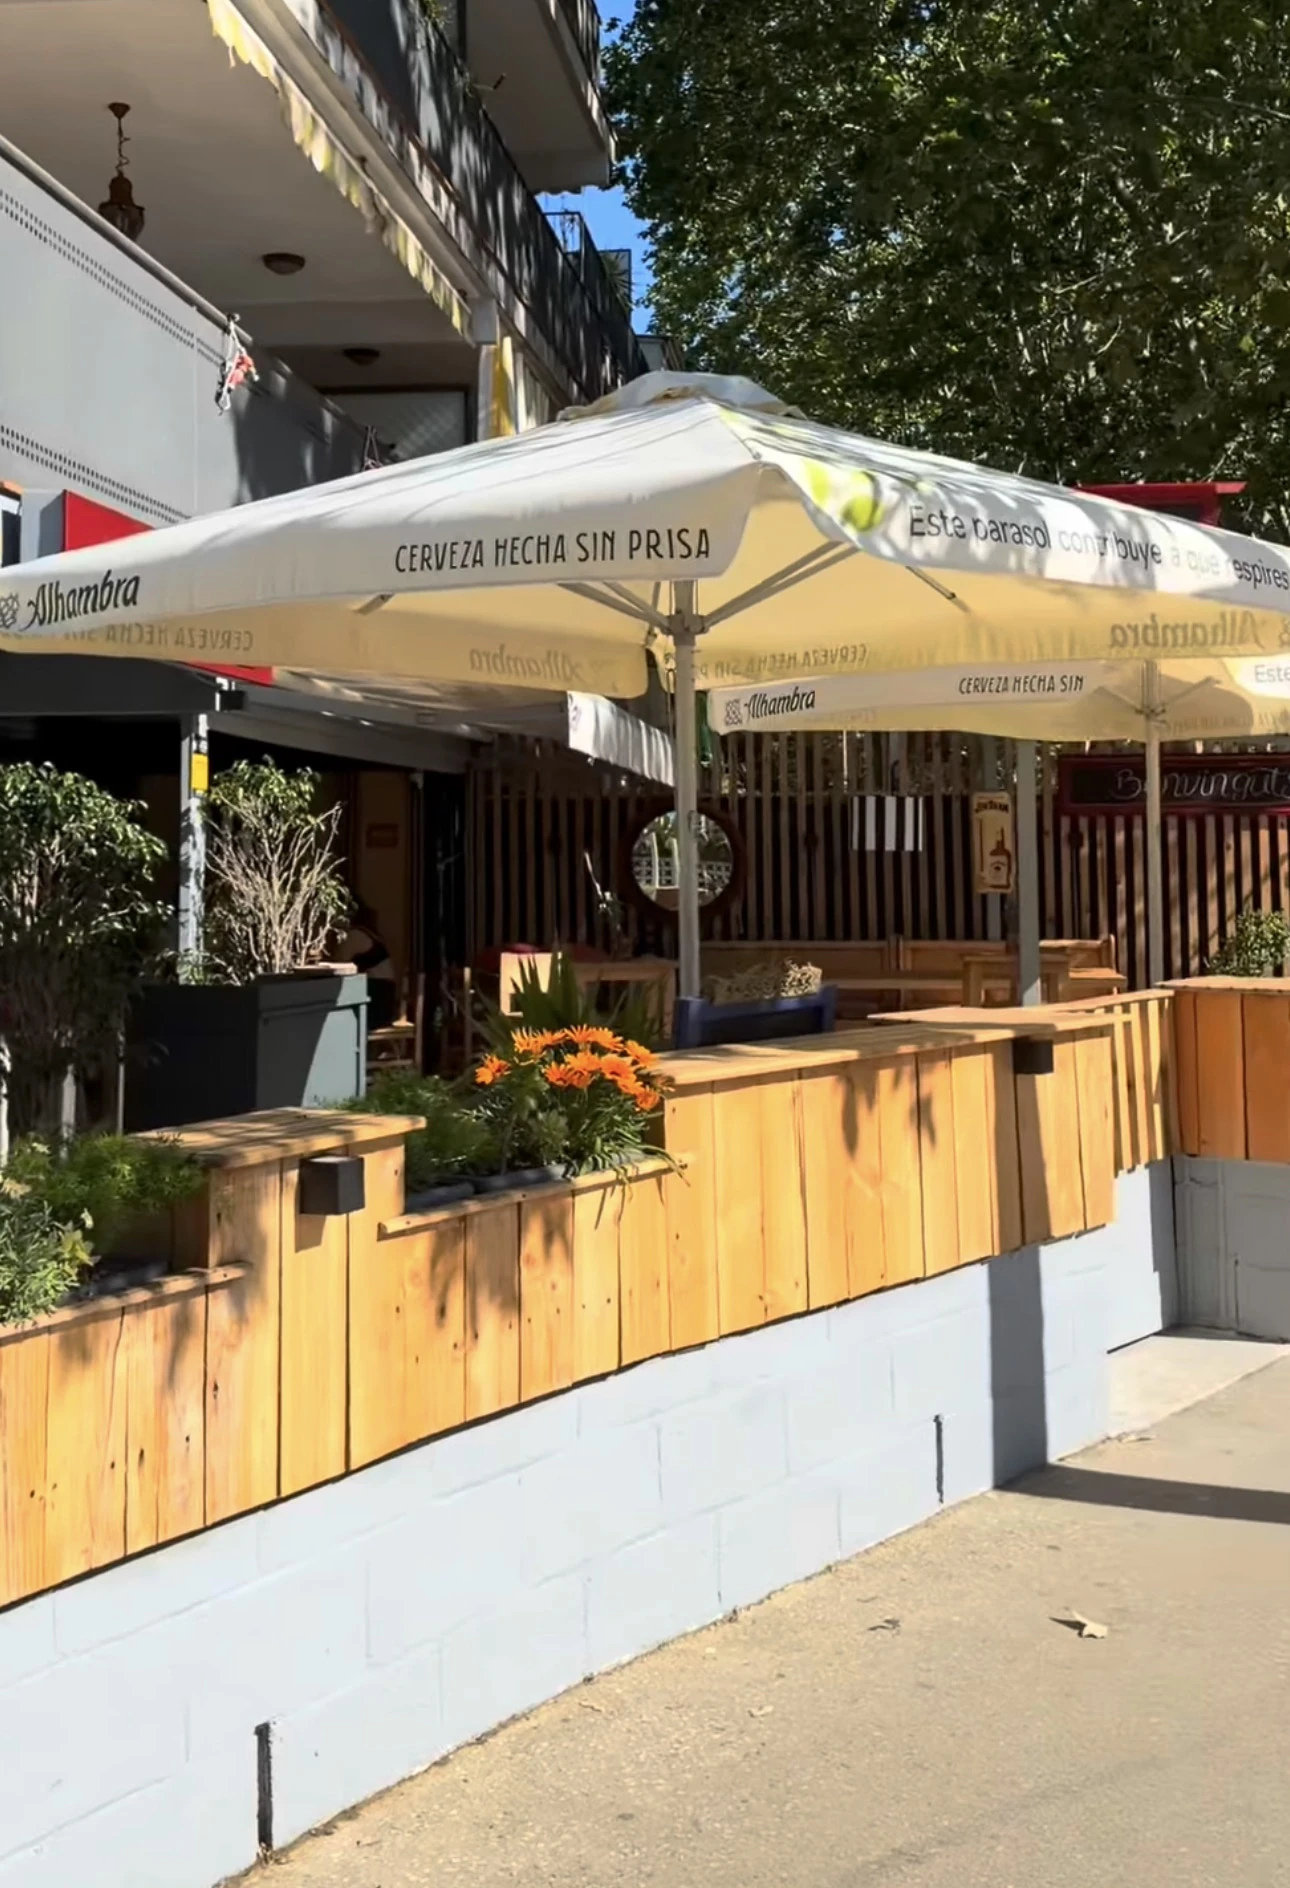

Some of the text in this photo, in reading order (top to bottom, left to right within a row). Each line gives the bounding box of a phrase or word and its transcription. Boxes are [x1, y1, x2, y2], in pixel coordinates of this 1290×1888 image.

[395, 528, 710, 573] CERVEZA HECHA SIN PRISA
[909, 506, 966, 538] Este
[972, 518, 1052, 549] parasol
[1058, 529, 1163, 569] contribuye
[1227, 557, 1290, 590] respires
[20, 569, 141, 631] Alhambra
[744, 686, 816, 721] Alhambra
[959, 674, 1084, 694] CERVEZA HECHA SIN
